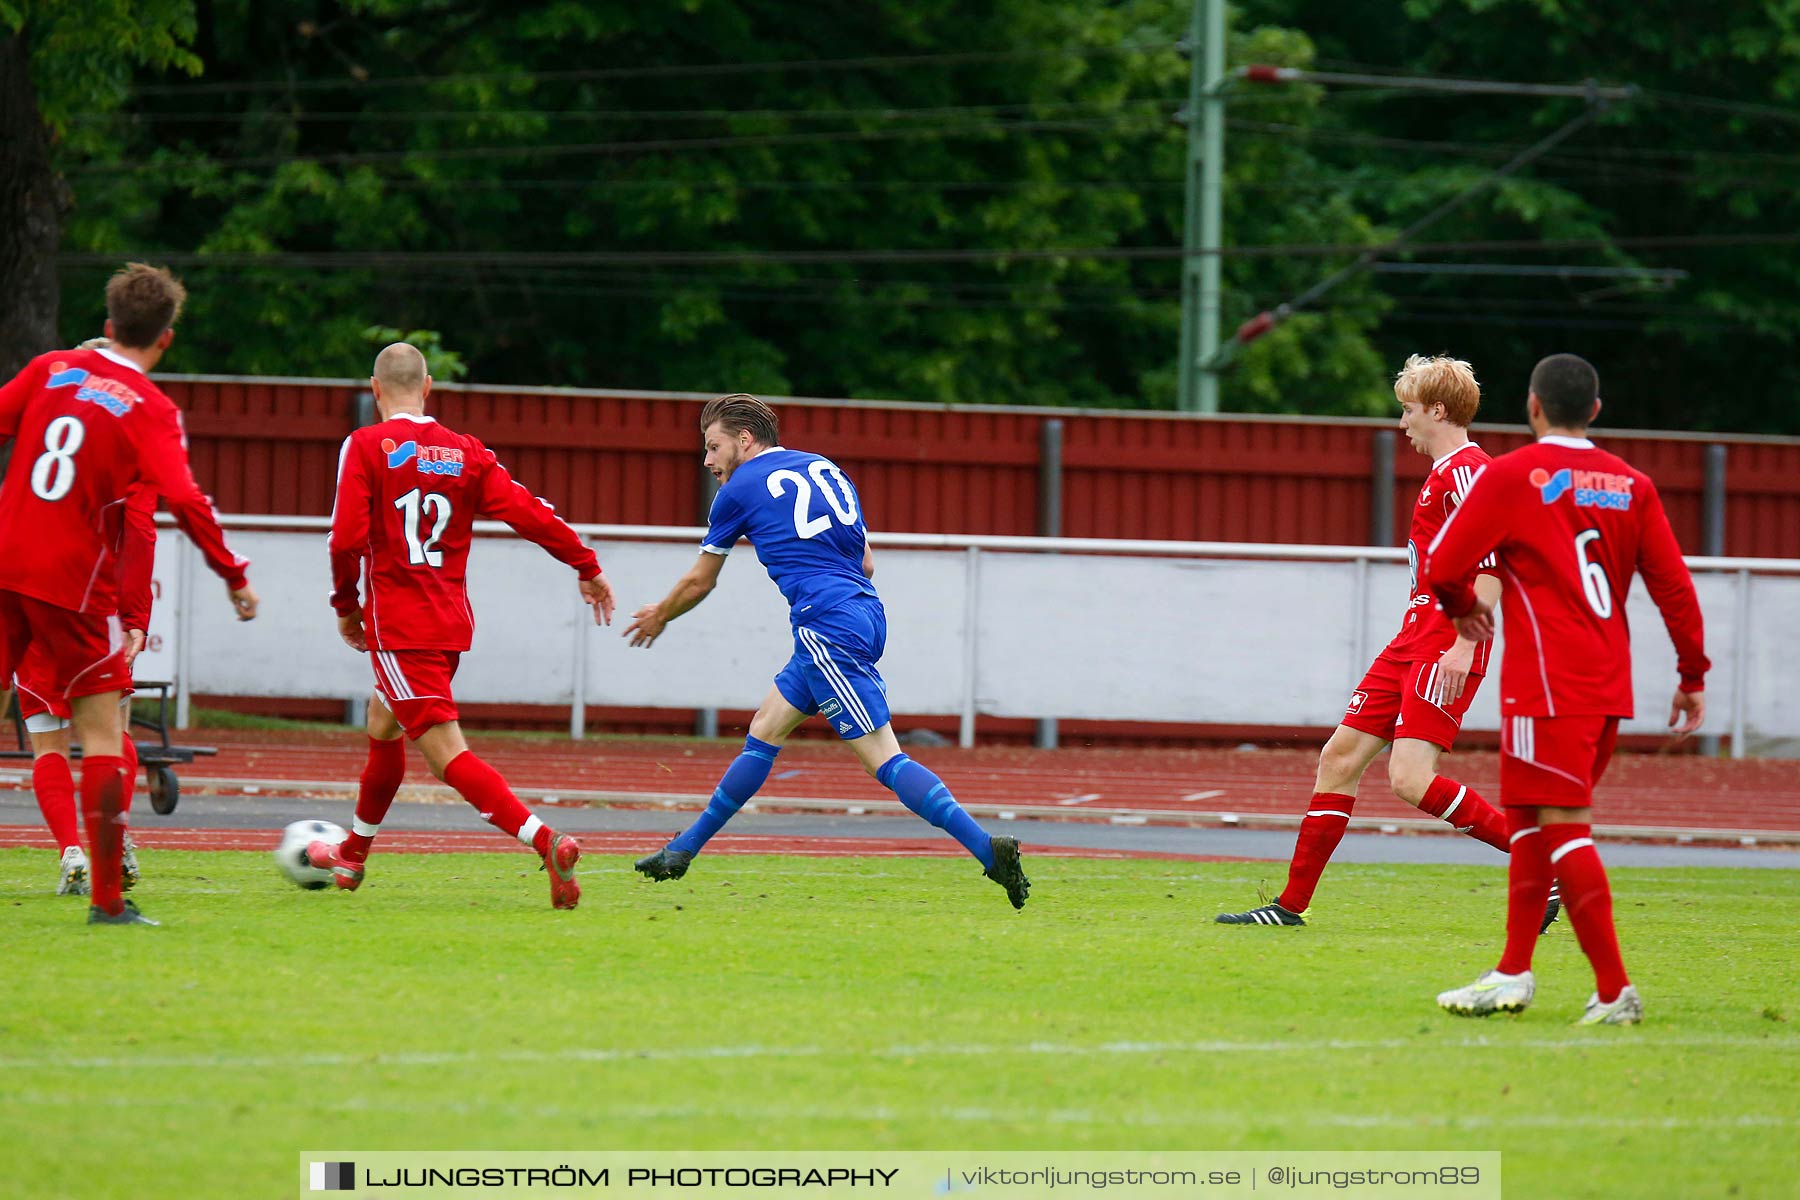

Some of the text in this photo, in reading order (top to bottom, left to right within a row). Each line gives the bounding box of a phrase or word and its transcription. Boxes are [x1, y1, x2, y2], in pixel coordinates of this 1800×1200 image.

[75, 388, 131, 417] SPORT
[31, 416, 85, 501] 8
[417, 458, 464, 476] SPORT
[394, 488, 452, 567] 12
[766, 460, 858, 540] 20
[1574, 487, 1632, 511] SPORT
[1574, 529, 1612, 619] 6
